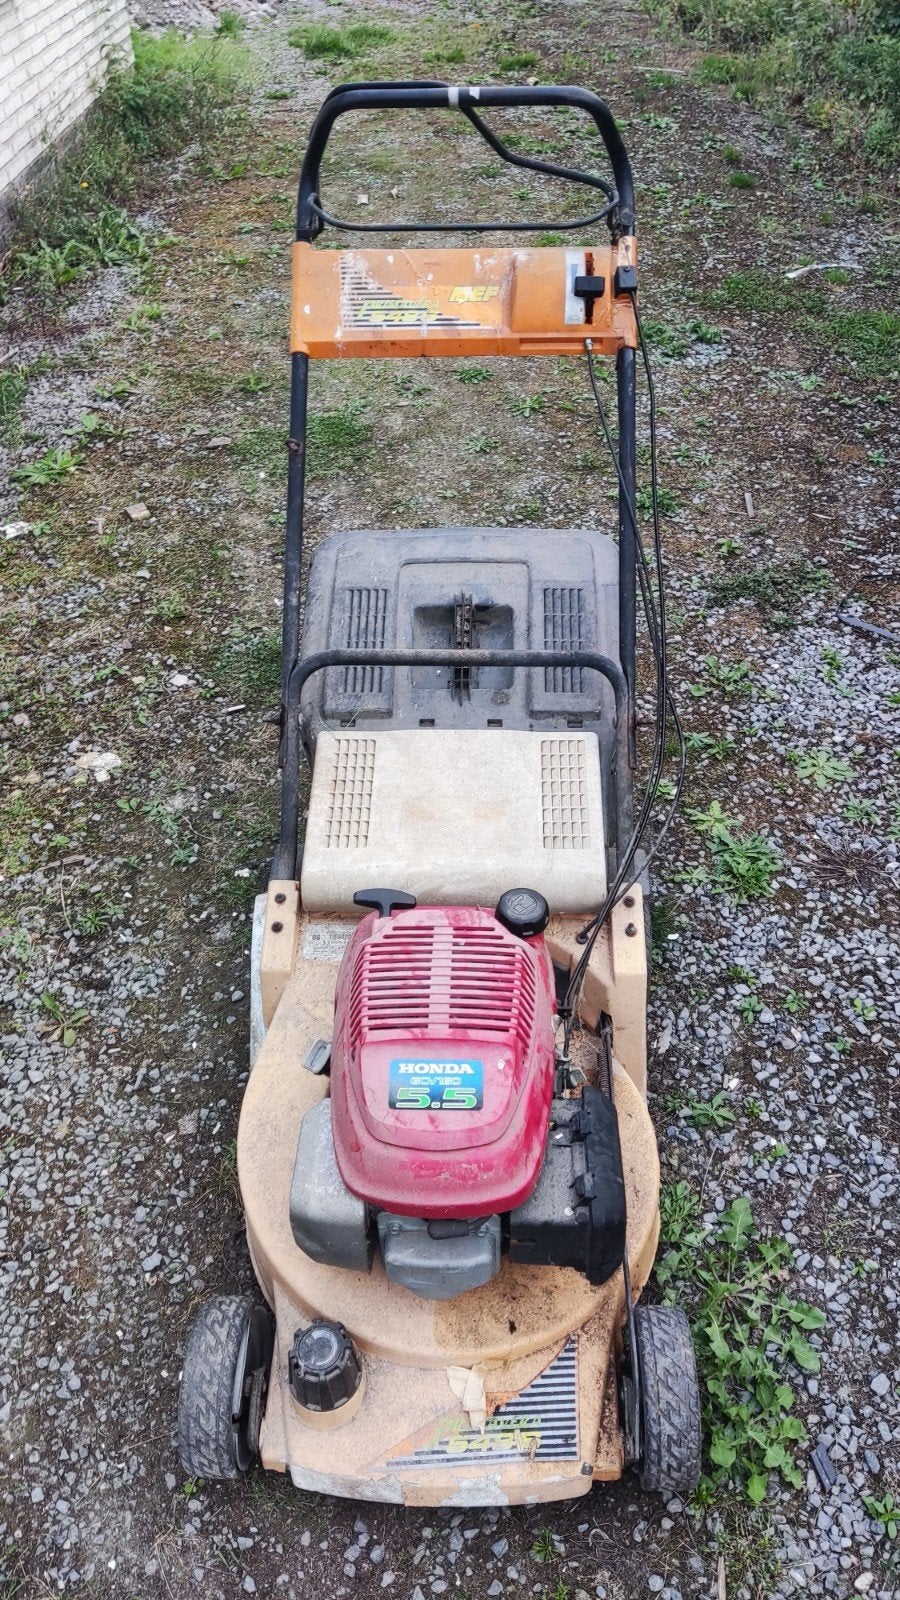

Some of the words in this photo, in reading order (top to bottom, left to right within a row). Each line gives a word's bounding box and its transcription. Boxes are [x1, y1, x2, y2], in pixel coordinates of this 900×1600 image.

[398, 1063, 475, 1075] HONDA
[410, 1076, 463, 1086] GCV160
[395, 1087, 478, 1109] 5.5
